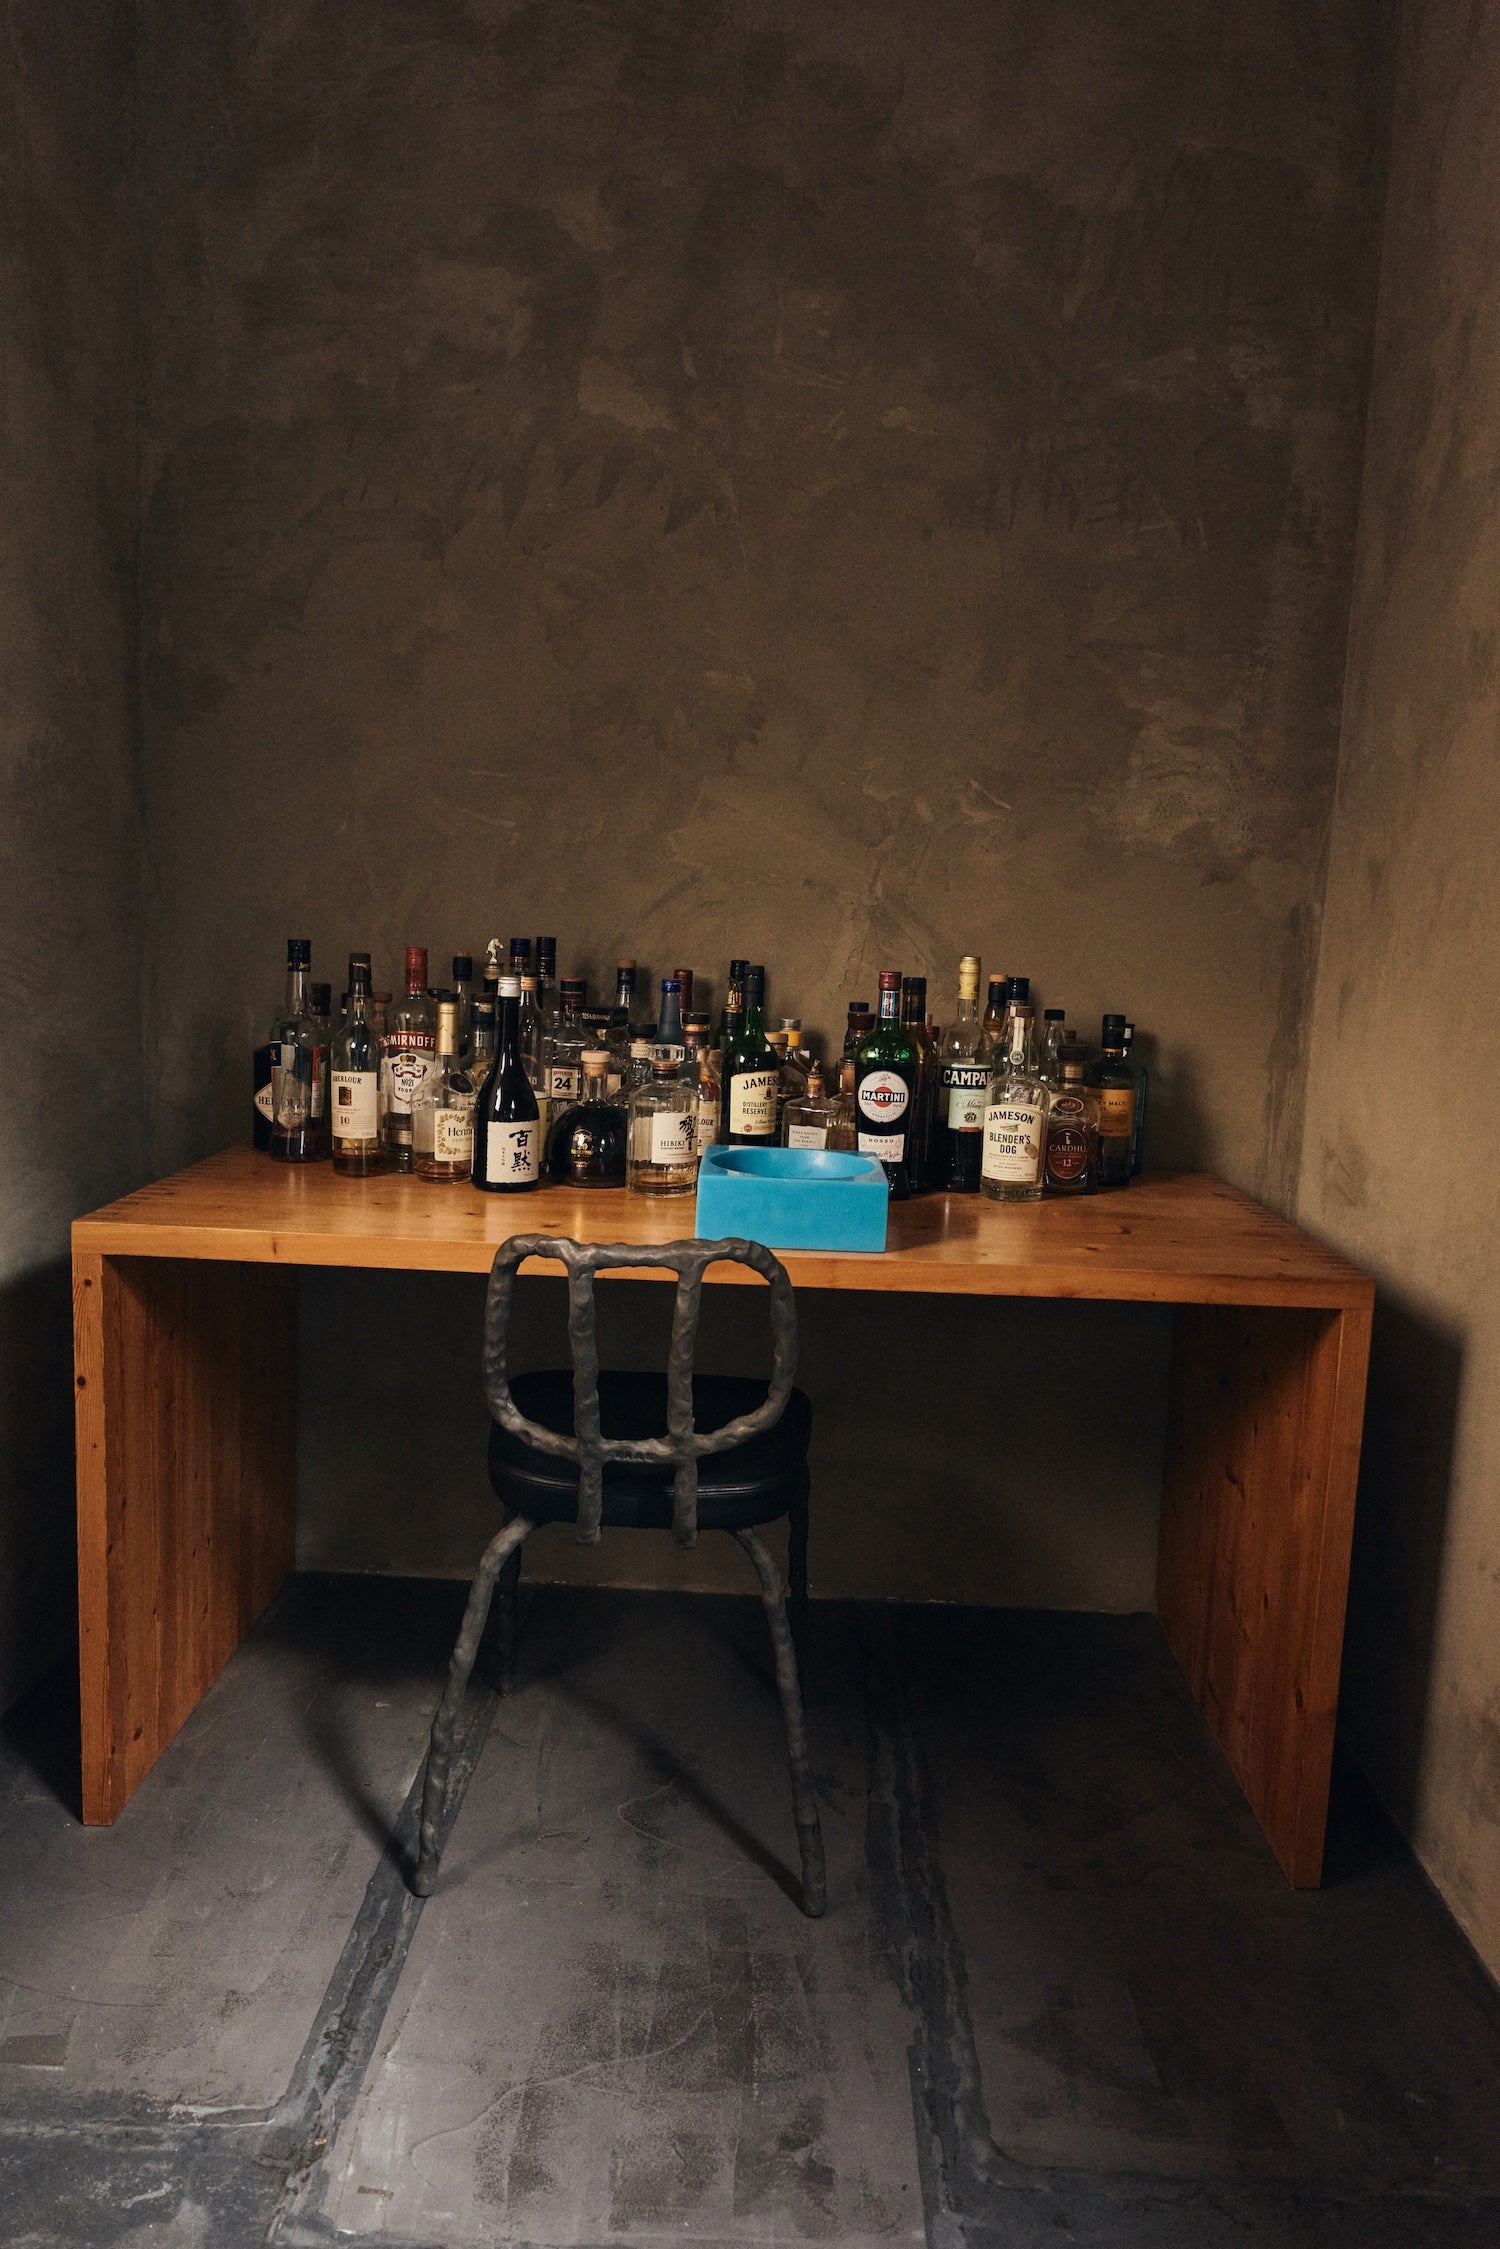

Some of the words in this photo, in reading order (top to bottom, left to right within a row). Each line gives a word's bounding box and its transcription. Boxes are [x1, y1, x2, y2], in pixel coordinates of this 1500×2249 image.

[554, 1077, 572, 1090] 24
[862, 1091, 904, 1102] MARTINI
[340, 1116, 350, 1125] 10
[988, 1110, 1035, 1125] JAMESON
[989, 1131, 1031, 1145] BLENDER'S
[999, 1144, 1017, 1155] DOG
[1049, 1144, 1088, 1153] CARDHU
[1062, 1158, 1073, 1168] 12
